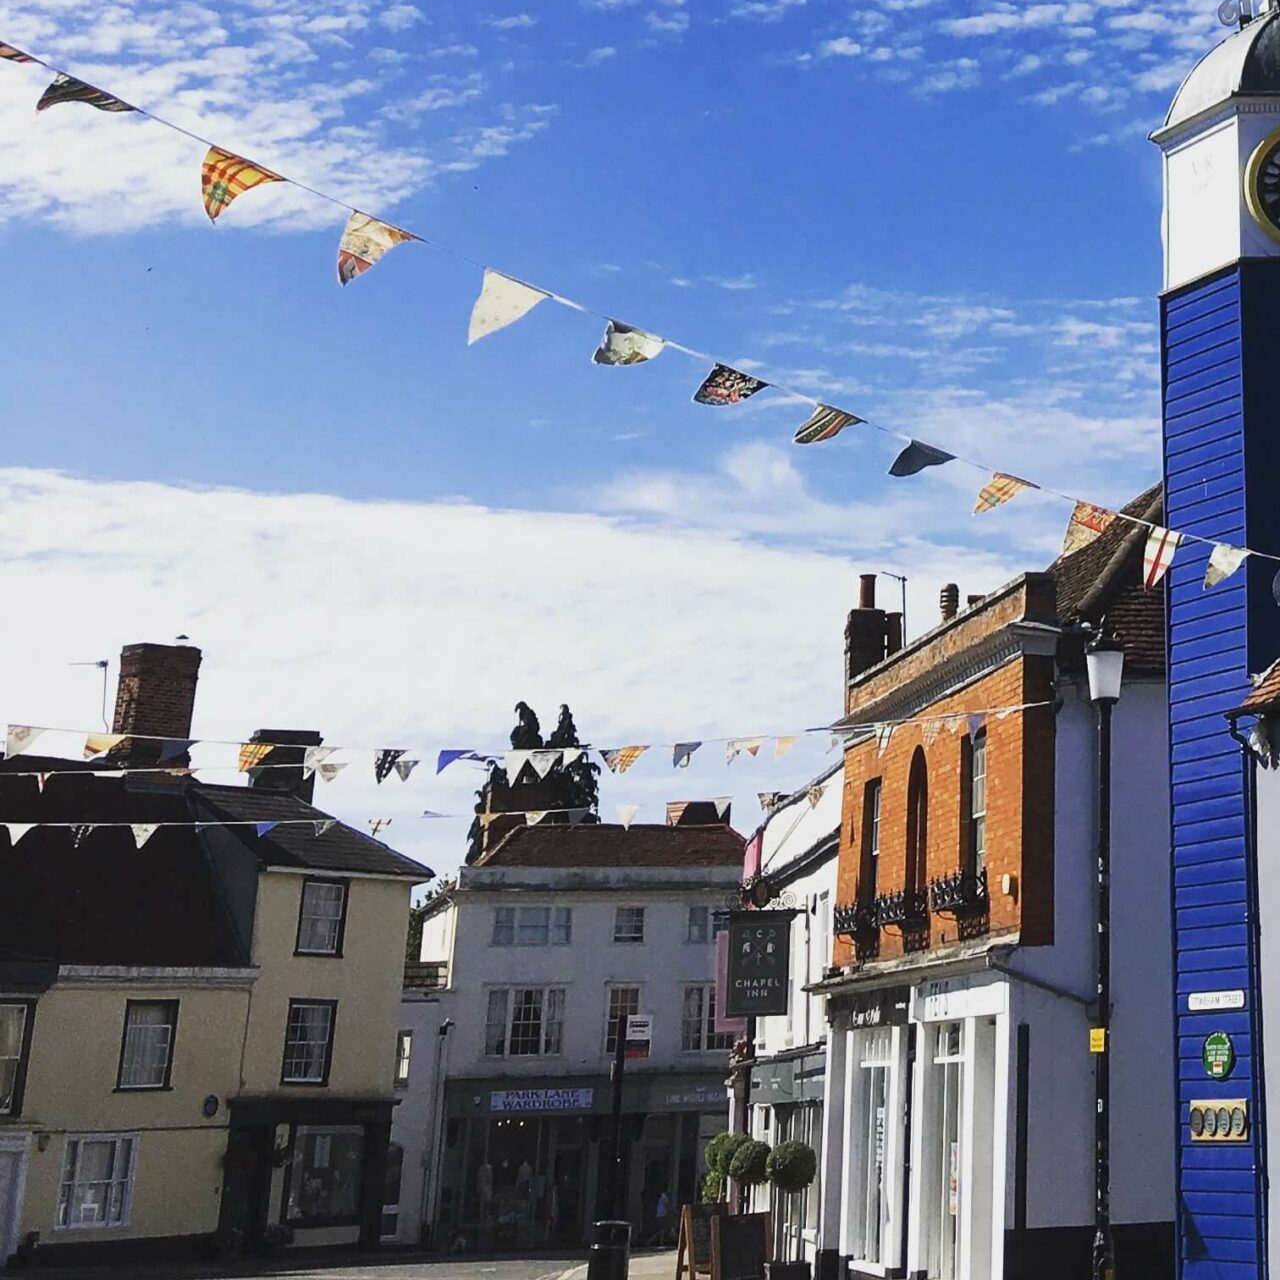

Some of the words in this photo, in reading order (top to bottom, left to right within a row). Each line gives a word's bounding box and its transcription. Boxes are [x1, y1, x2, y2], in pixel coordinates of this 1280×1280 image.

[735, 979, 780, 988] CHAPEL
[746, 989, 768, 998] INN
[505, 1090, 542, 1100] PARK
[544, 1089, 580, 1099] LANE
[502, 1098, 580, 1109] WARDROBE
